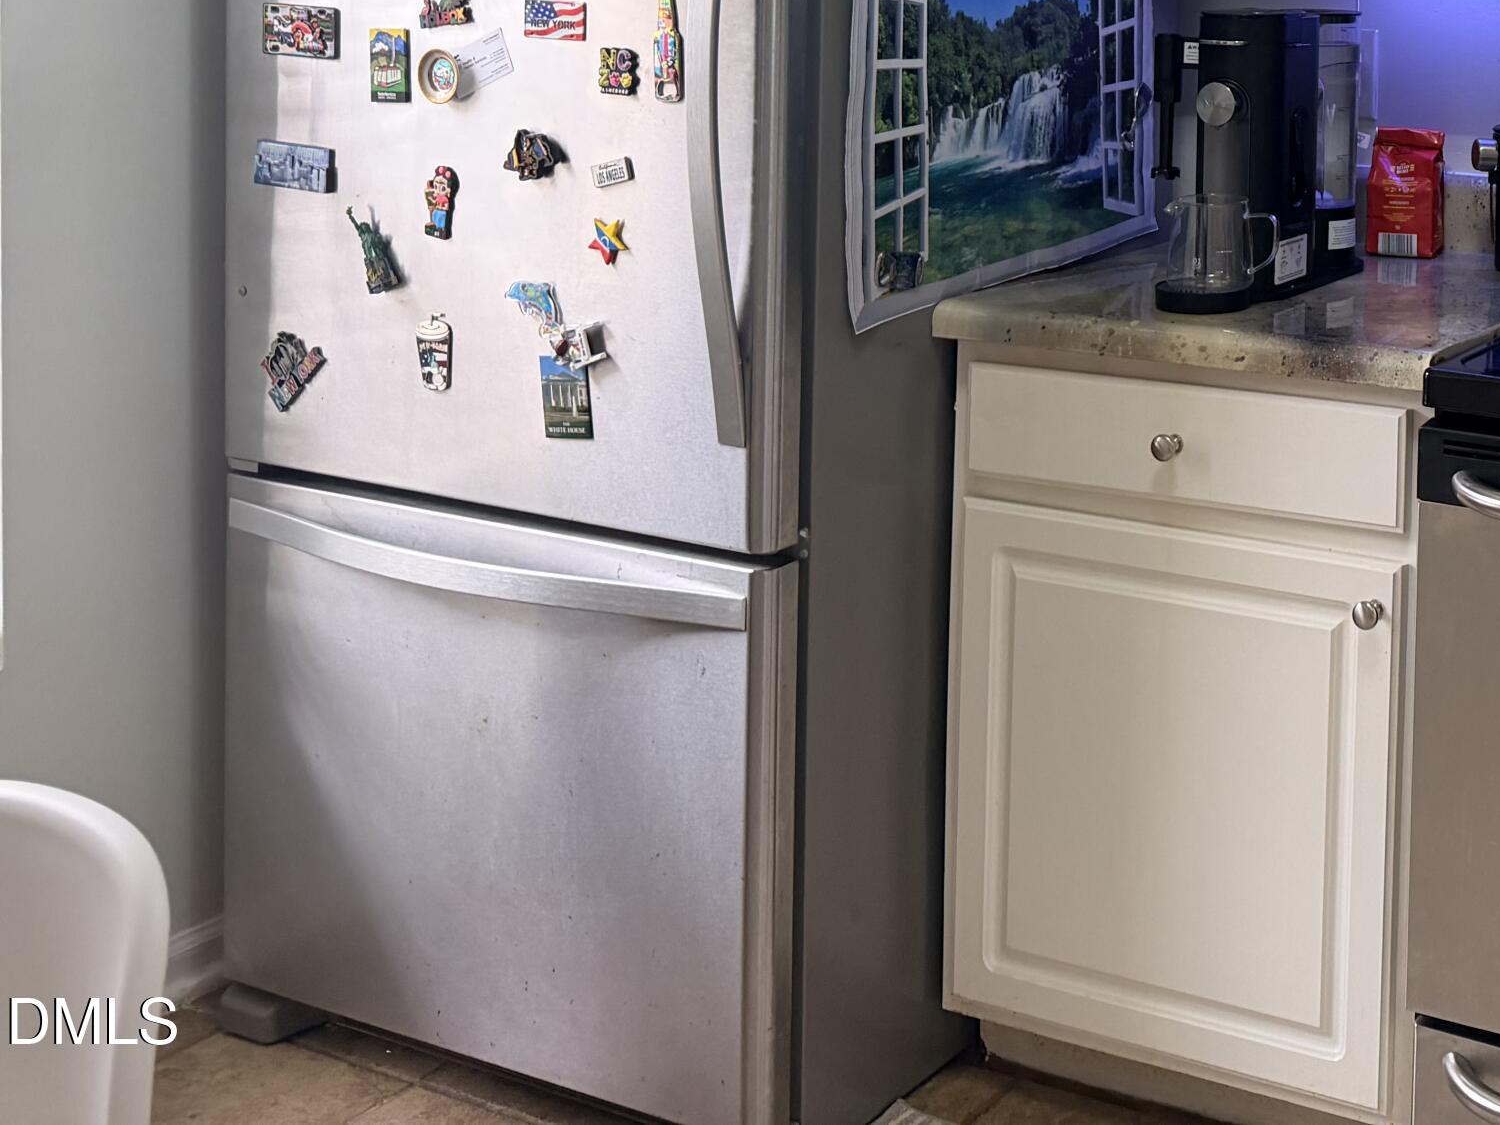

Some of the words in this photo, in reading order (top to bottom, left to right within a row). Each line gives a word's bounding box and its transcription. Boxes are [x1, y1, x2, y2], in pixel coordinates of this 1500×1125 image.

[530, 18, 550, 28] NEW
[552, 19, 577, 30] YORK
[600, 48, 632, 72] NC
[596, 172, 606, 185] LOS
[605, 166, 626, 184] ANGELES
[547, 426, 567, 434] WHITE
